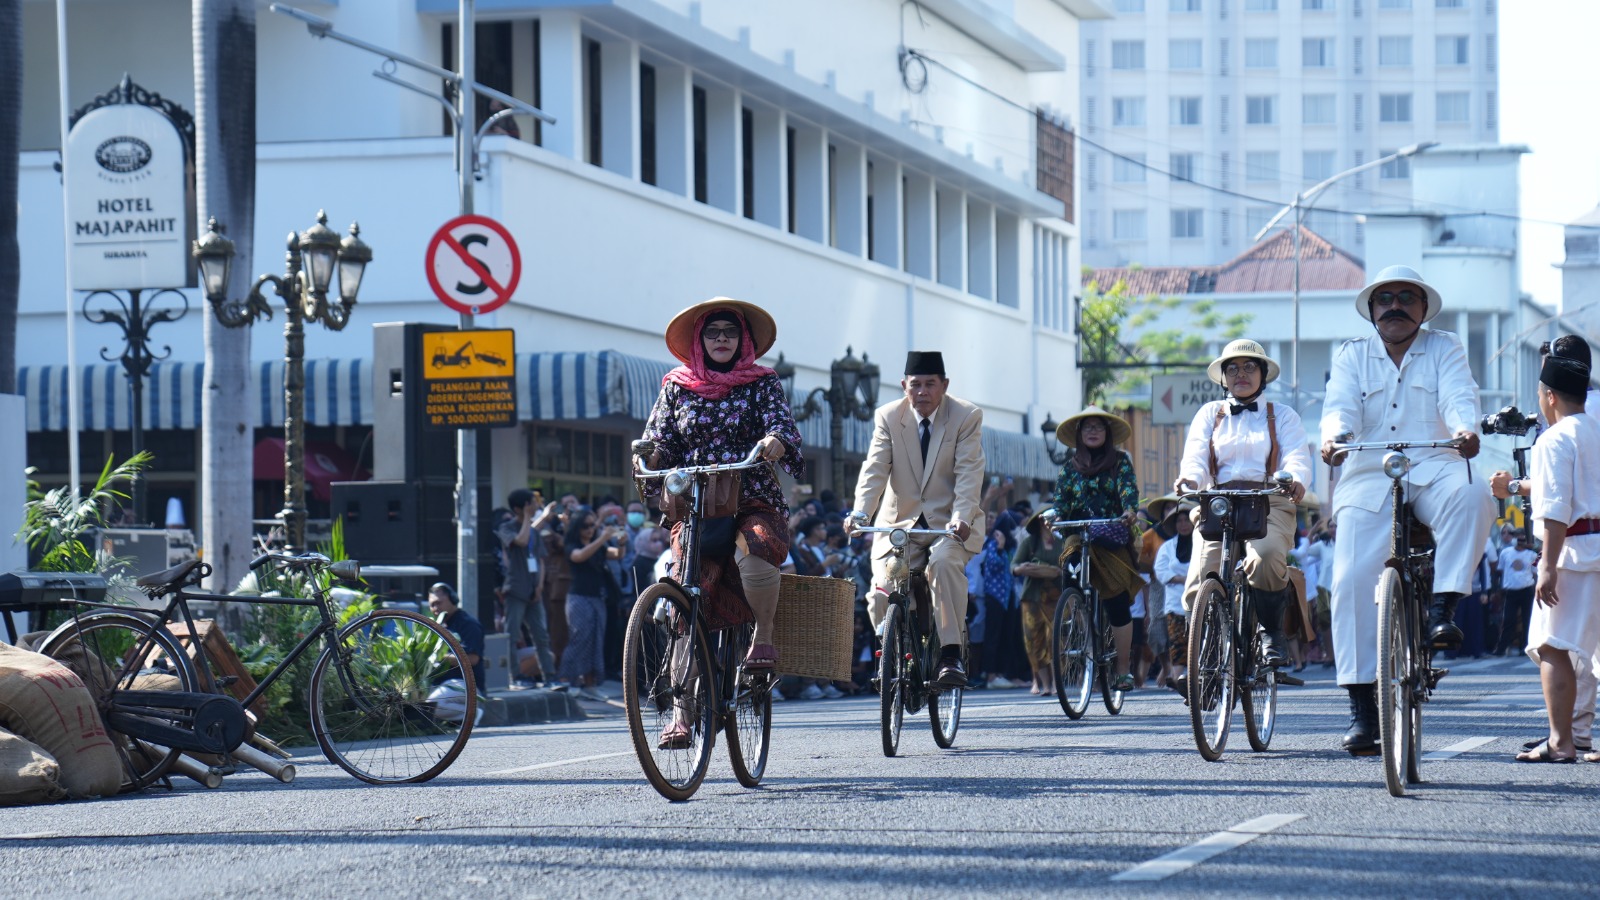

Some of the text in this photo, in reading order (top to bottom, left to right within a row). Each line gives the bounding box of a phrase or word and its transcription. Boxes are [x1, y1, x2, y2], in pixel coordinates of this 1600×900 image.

[98, 198, 153, 213] HOTEL
[76, 218, 176, 236] MAJAPAHIT
[104, 250, 147, 259] SURABAYA
[455, 233, 492, 295] S
[431, 382, 481, 392] PELANGGAR
[426, 405, 455, 414] DENDA
